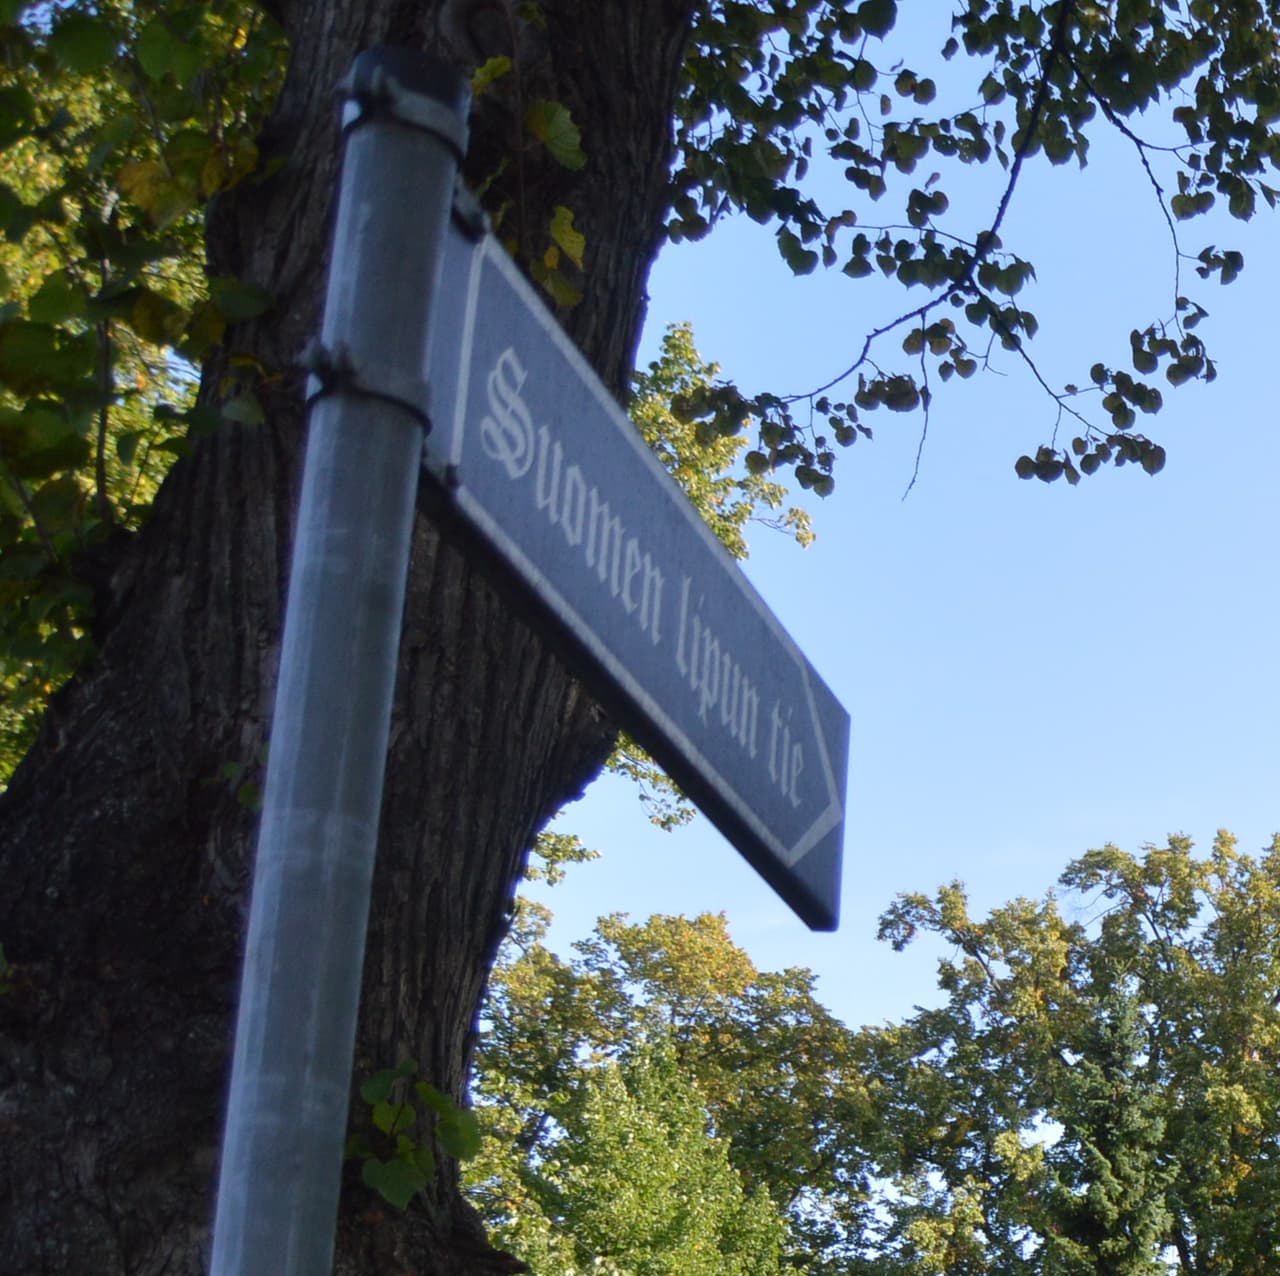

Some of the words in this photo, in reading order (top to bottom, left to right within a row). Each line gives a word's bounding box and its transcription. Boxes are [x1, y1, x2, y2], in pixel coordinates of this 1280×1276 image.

[480, 346, 664, 645] Suomen
[676, 576, 760, 760] lipun
[768, 699, 803, 808] tie
